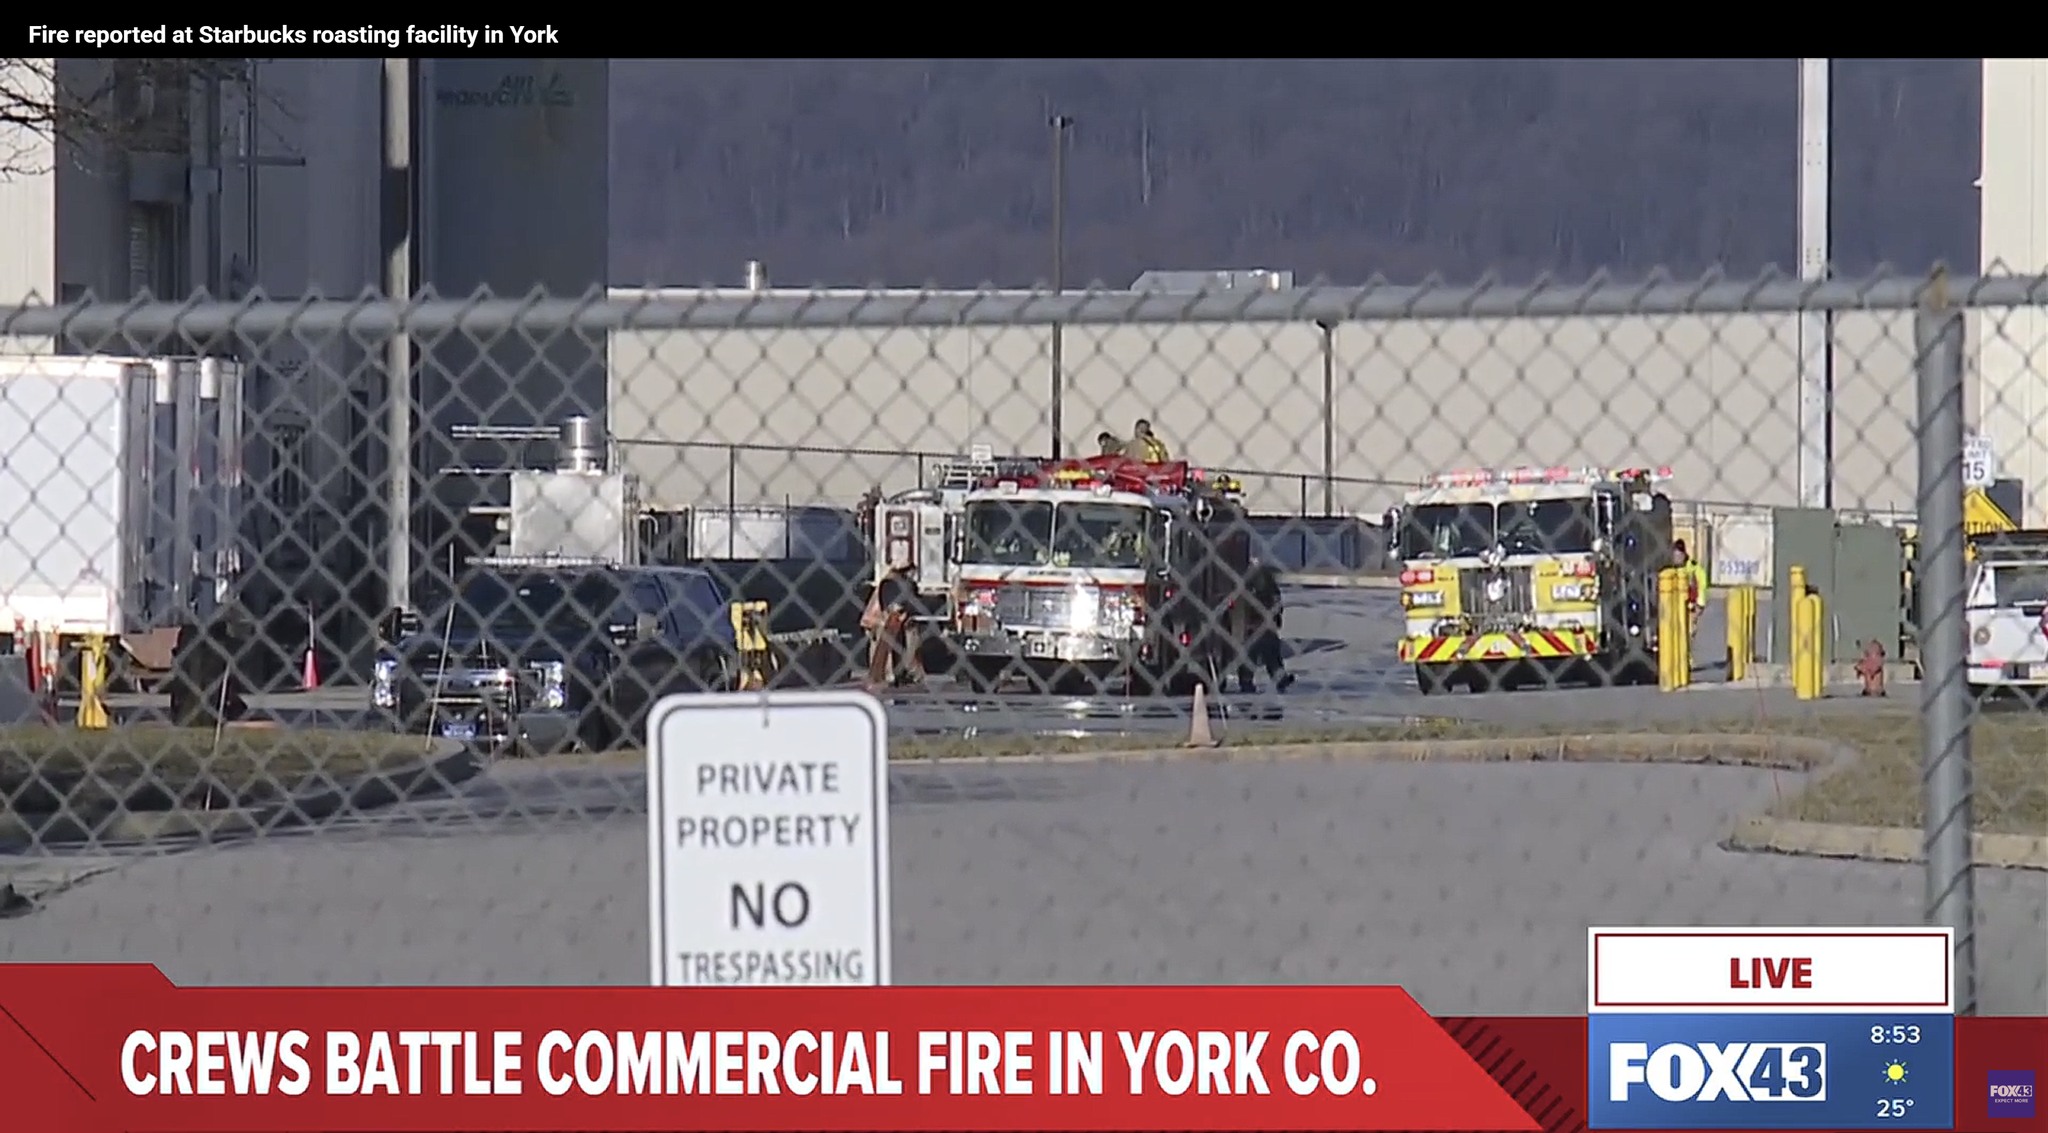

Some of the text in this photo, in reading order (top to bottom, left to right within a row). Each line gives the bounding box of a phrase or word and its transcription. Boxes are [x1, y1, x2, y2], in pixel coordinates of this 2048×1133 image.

[1963, 461, 1985, 481] 15
[696, 763, 840, 794] PRIVATE
[677, 815, 861, 848] PROPERTY
[729, 880, 811, 931] NO
[678, 951, 864, 984] TRESPASSING
